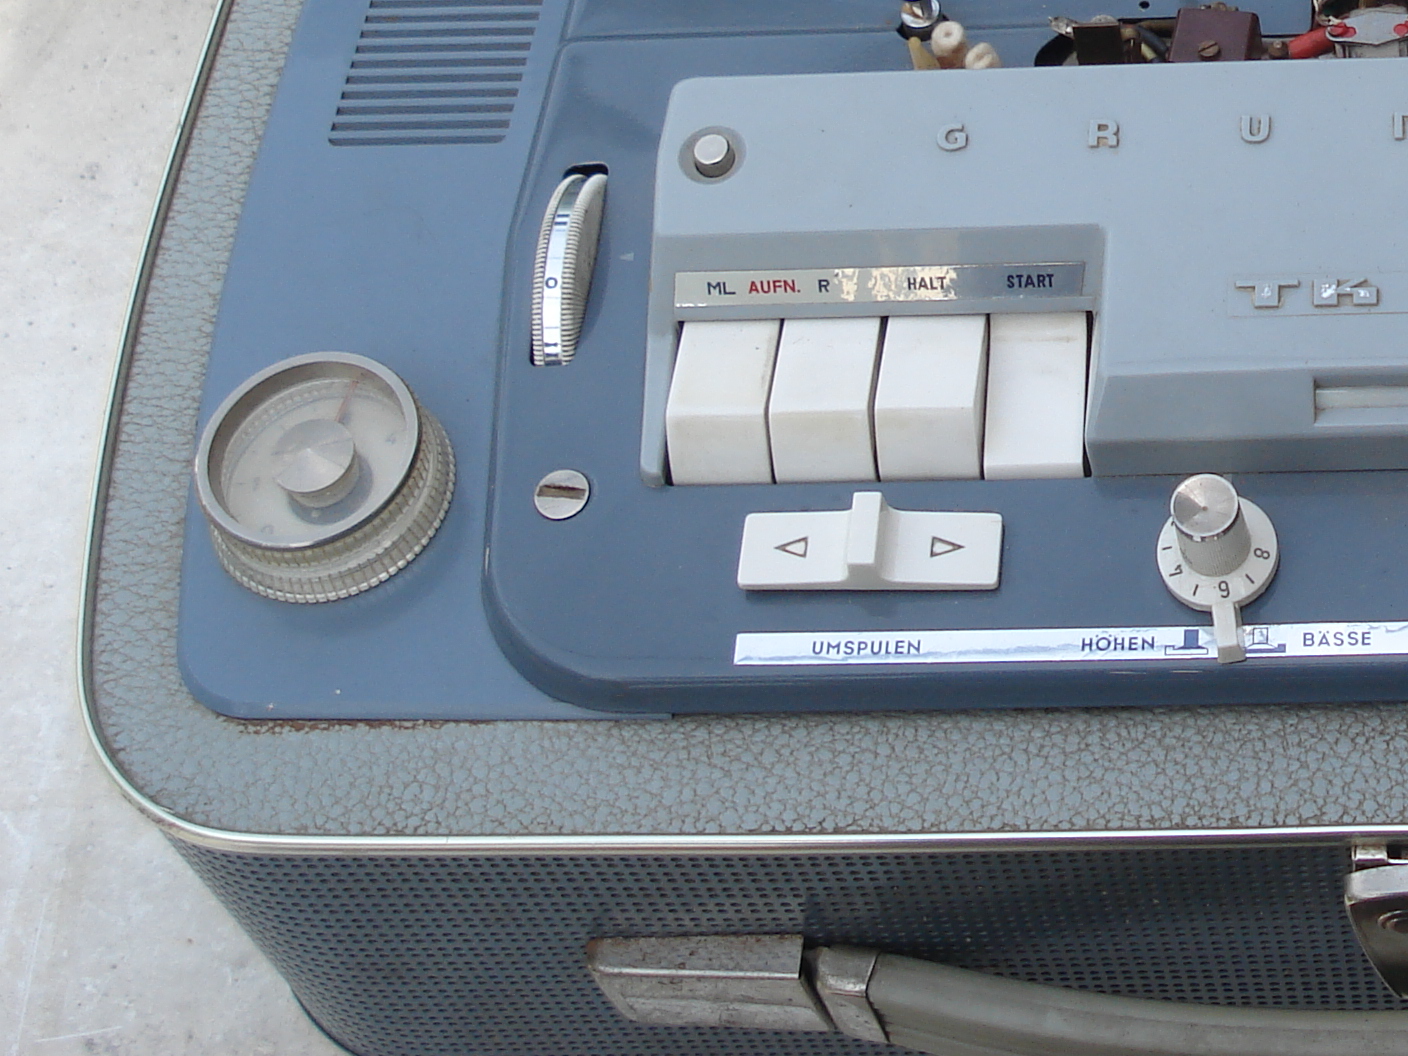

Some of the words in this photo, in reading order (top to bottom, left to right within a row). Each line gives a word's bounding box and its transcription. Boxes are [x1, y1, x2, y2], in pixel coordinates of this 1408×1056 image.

[706, 281, 737, 295] ML
[748, 279, 801, 294] AUFN.
[817, 279, 831, 293] R
[907, 276, 947, 290] HALT
[1006, 274, 1055, 290] START
[1234, 276, 1381, 309] TK
[1253, 547, 1271, 560] 8
[1080, 633, 1156, 652] HÖHEN
[1302, 630, 1373, 647] BÄSSE
[811, 639, 922, 655] UMSPULEN
